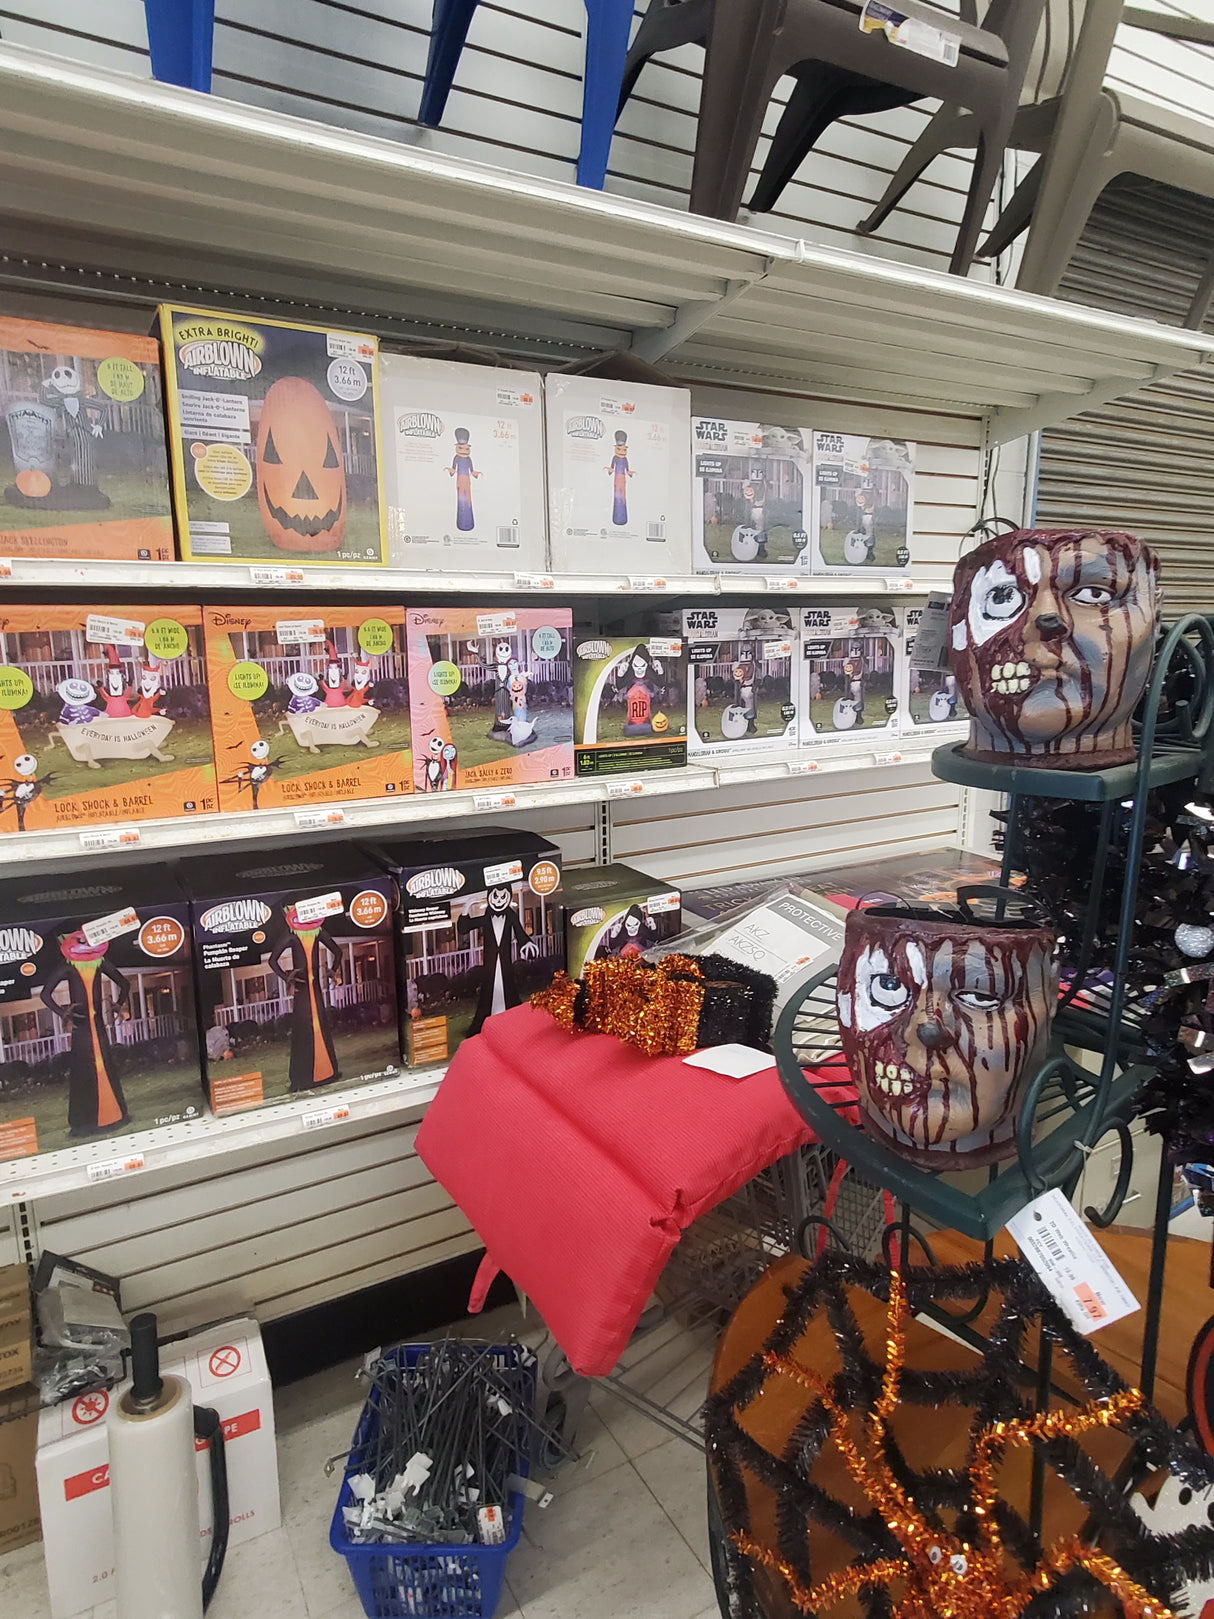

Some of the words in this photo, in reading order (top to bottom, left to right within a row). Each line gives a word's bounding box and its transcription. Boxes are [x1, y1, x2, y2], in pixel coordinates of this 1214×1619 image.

[178, 326, 213, 340] EXTRA
[216, 327, 259, 349] BRIGHT!
[184, 341, 256, 378] AIRBLOWN
[192, 366, 247, 380] INFLATABLE
[339, 365, 348, 375] 12
[349, 367, 356, 376] ft
[334, 376, 352, 386] 3.66
[353, 379, 361, 387] m
[399, 412, 443, 437] AIRBLOWN
[497, 420, 505, 429] 12
[696, 421, 728, 432] STAR
[493, 429, 510, 439] 3.66
[696, 430, 728, 442] WARS
[816, 434, 845, 444] STAR
[816, 443, 845, 453] WARS
[157, 547, 163, 560] 1
[686, 611, 718, 620] STAR
[804, 610, 832, 619] STAR
[907, 609, 923, 618] STA
[208, 611, 252, 629] Disney
[409, 612, 445, 628] Disney
[686, 620, 718, 629] WARS
[804, 619, 831, 627] WARS
[907, 618, 920, 626] WA
[234, 673, 253, 681] LIGHTS
[631, 701, 648, 718] RIP
[305, 716, 330, 729] EVERYDAY
[339, 714, 366, 730] HALLOWEEN
[80, 727, 113, 742] EVERYDAY
[114, 735, 121, 743] IS
[123, 725, 158, 742] HALLOWEEN
[500, 767, 513, 776] ZERO
[561, 767, 566, 777] 1
[304, 780, 326, 792] SHOCK
[336, 777, 361, 788] BARREL
[399, 781, 404, 792] 1
[82, 799, 111, 812] SHOCK
[113, 799, 119, 808] &
[122, 795, 154, 807] BARREL
[200, 799, 206, 811] 1
[545, 866, 553, 874] ft
[409, 867, 461, 897] AIRBLOWN
[534, 876, 548, 885] 2.90
[548, 875, 555, 883] m
[361, 897, 369, 906] 12
[369, 896, 377, 904] ft
[204, 899, 266, 932] AIRBLOWN
[356, 907, 374, 917] 3.66
[373, 906, 382, 914] m
[777, 902, 844, 942] PROTECTIVE
[151, 924, 162, 933] 12
[163, 923, 171, 932] ft
[743, 922, 770, 940] AKZ
[146, 934, 167, 945] 3.66
[167, 933, 177, 941] m
[203, 947, 228, 957] Pumpkin
[228, 945, 249, 953] Reaper
[728, 935, 766, 961] AKZSQ
[211, 955, 232, 963] Muerte
[204, 961, 230, 970] calabaza
[92, 1571, 109, 1584] 2.0
